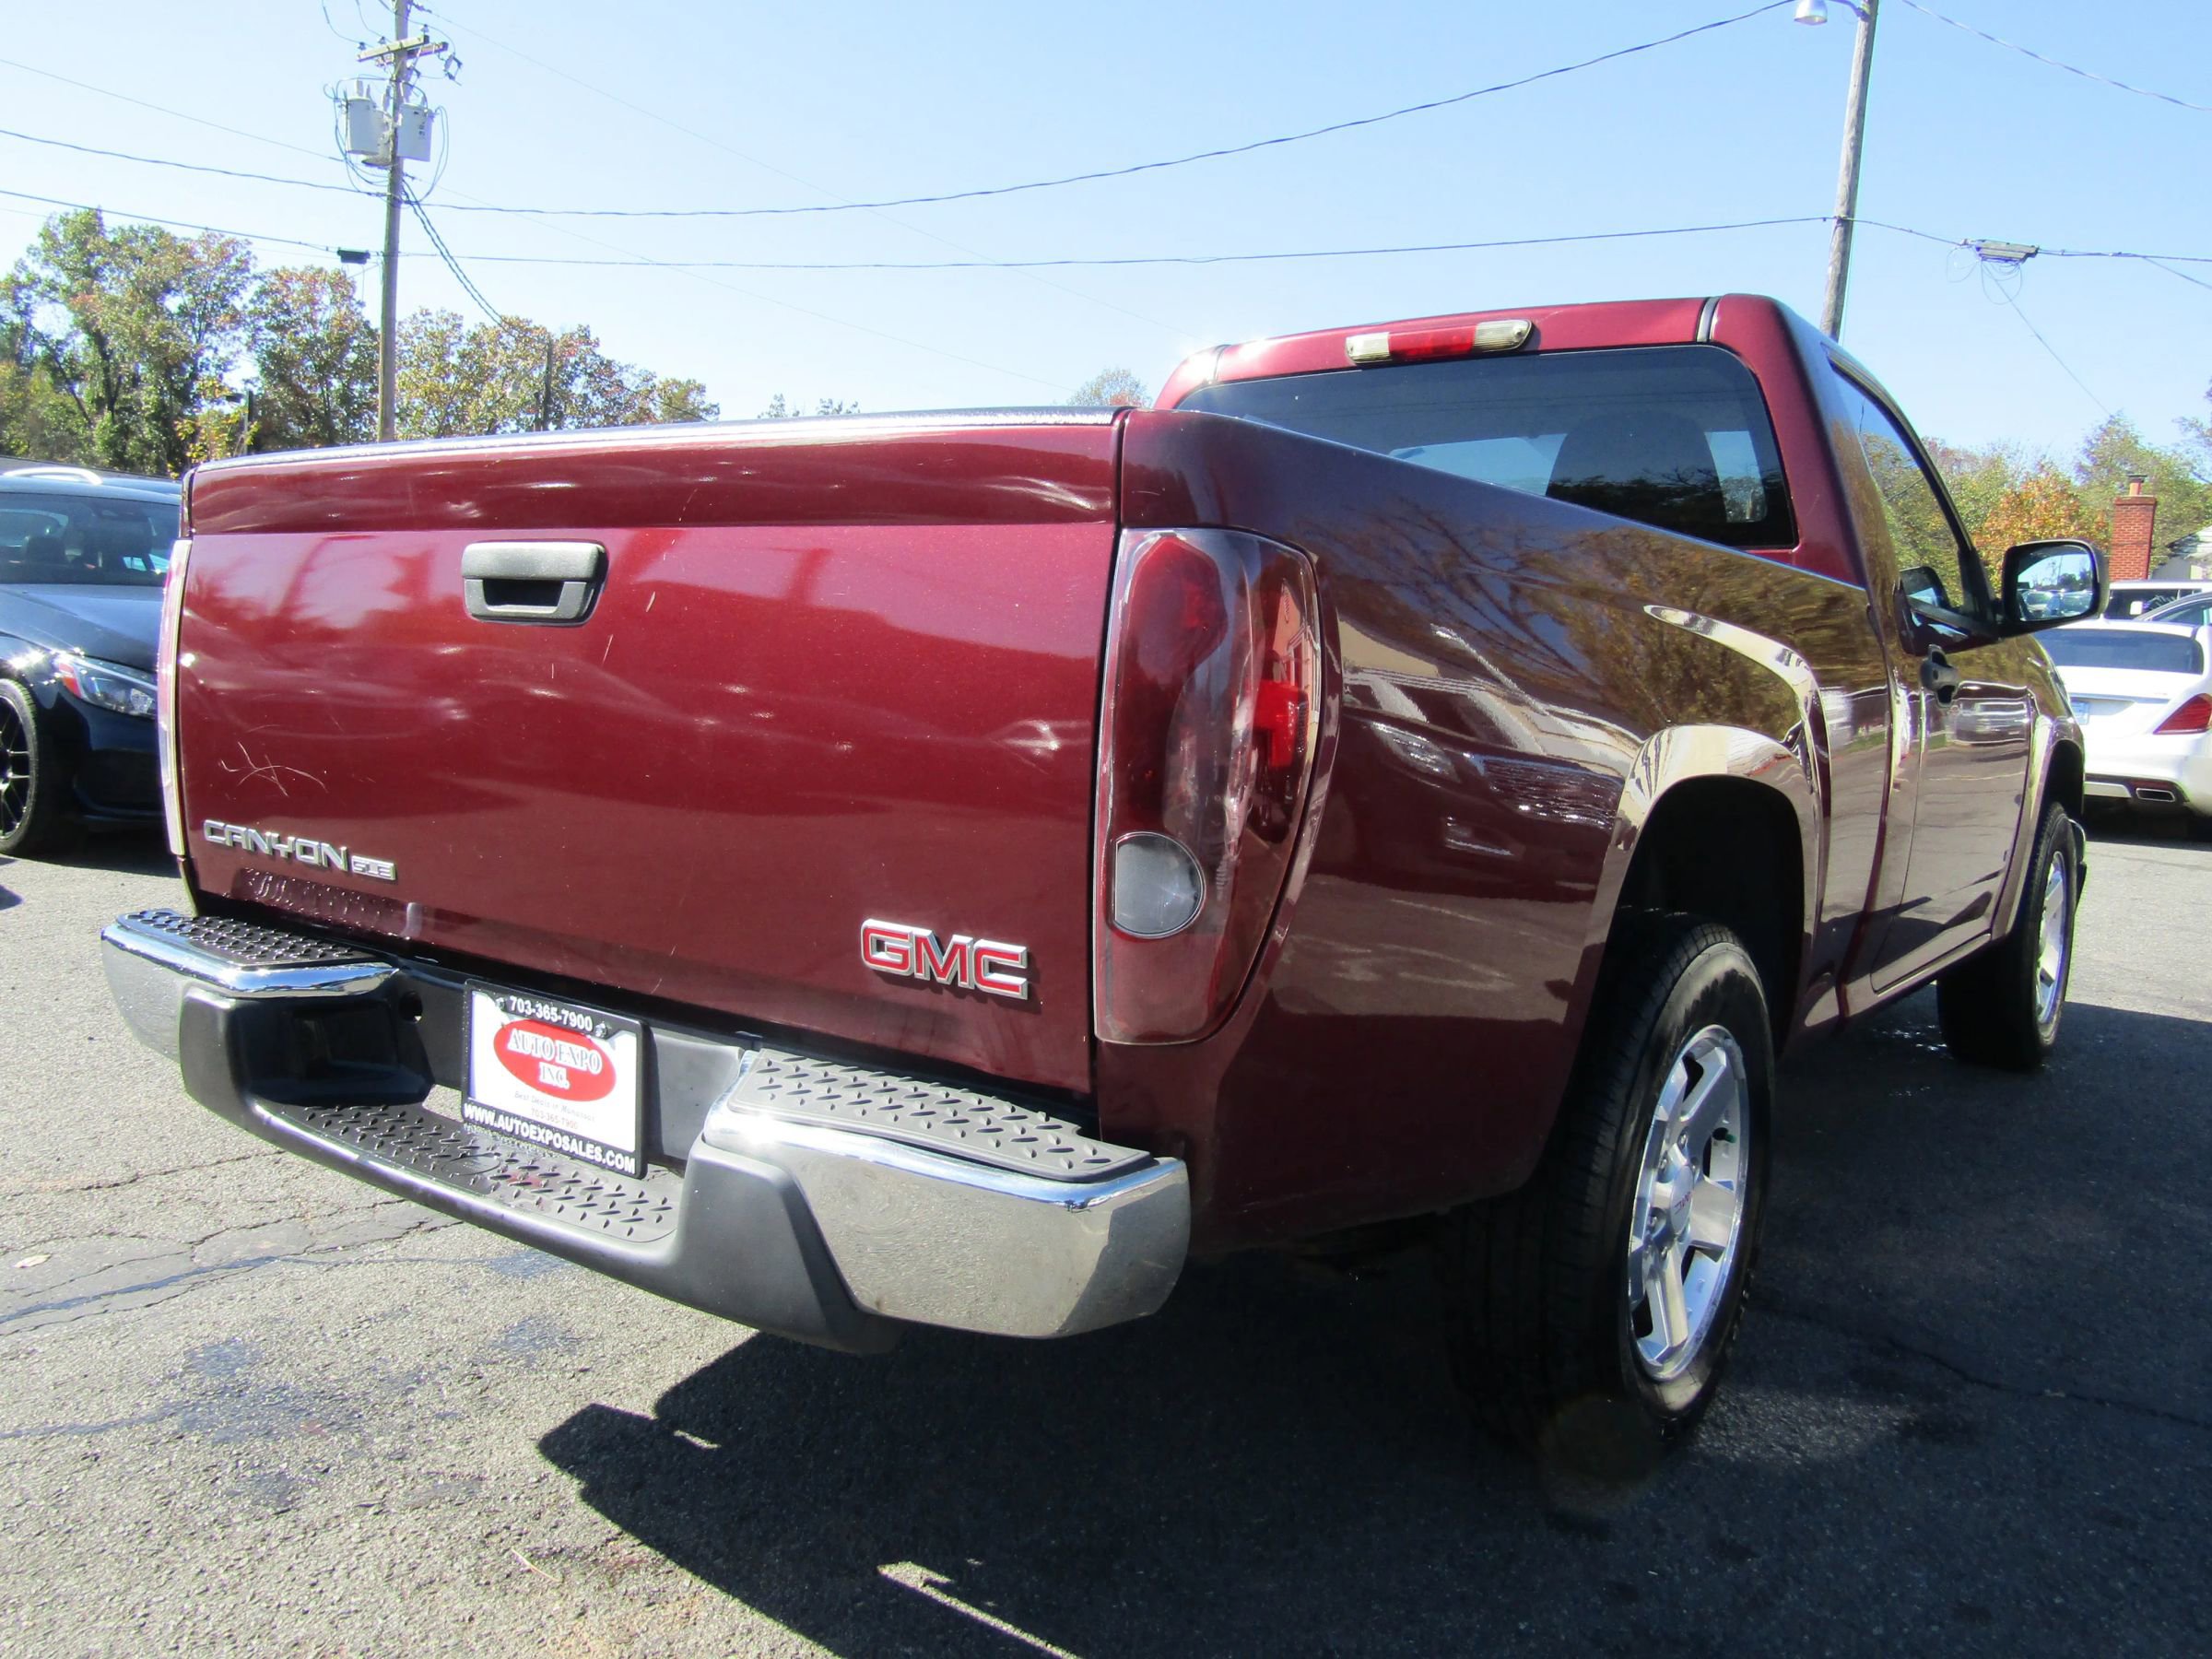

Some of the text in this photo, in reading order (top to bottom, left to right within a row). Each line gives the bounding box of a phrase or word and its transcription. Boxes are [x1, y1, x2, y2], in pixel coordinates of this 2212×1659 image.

[204, 819, 396, 881] CANYON SLE
[861, 918, 1028, 1000] GMC
[510, 995, 594, 1032] 703-365-7900
[508, 1028, 603, 1075] AUTO EXPO
[538, 1062, 570, 1089] INC.
[464, 1102, 636, 1175] WWW.AUTOEXPOSALES.COM
